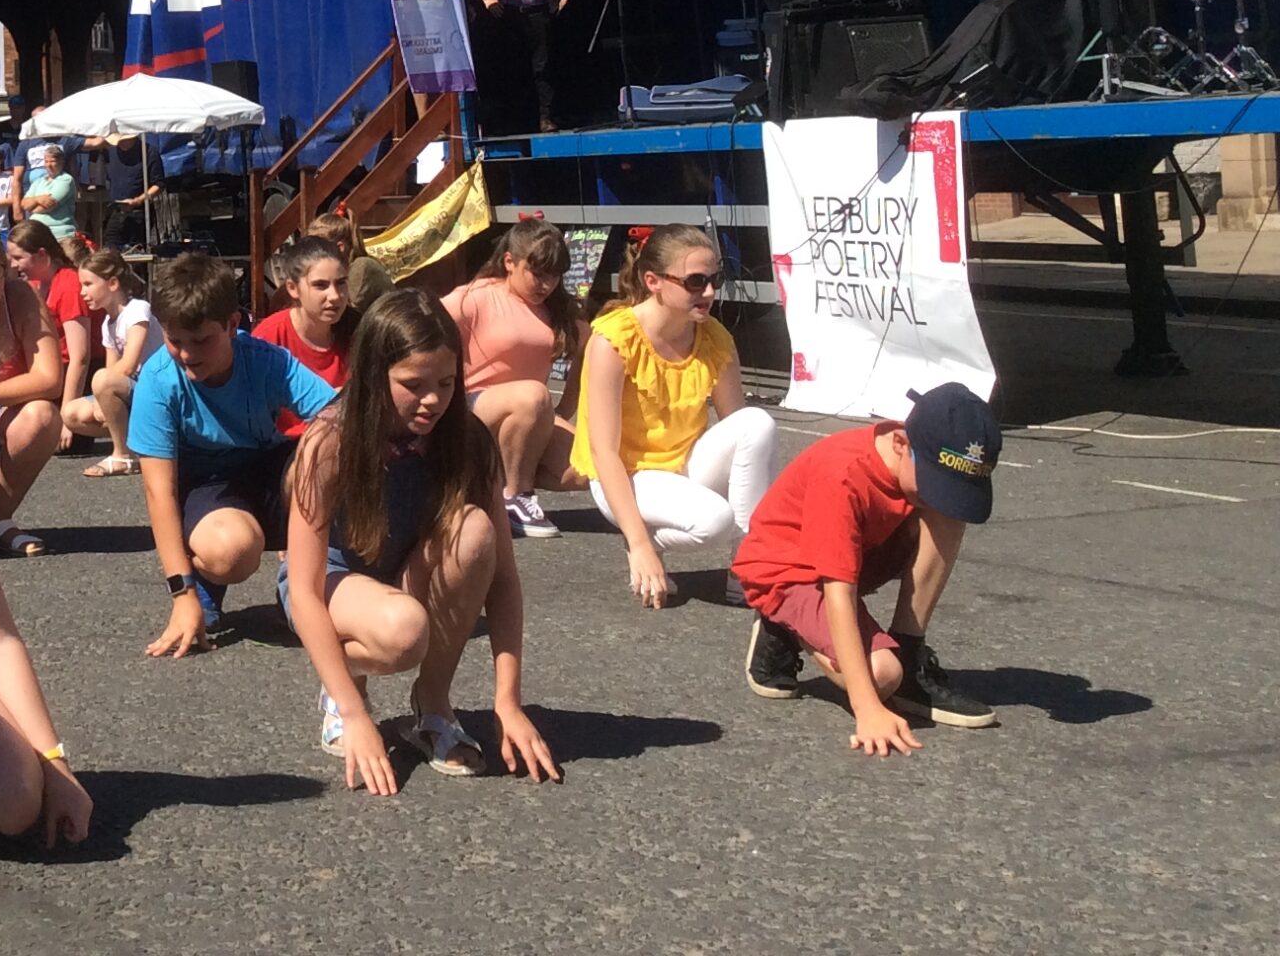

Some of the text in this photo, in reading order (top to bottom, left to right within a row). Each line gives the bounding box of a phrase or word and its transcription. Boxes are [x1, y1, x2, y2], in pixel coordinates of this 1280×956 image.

[801, 196, 919, 236] LEDBURY
[808, 238, 905, 280] POETRY
[814, 280, 928, 326] FESTIVAL
[938, 451, 992, 477] SORRENT
